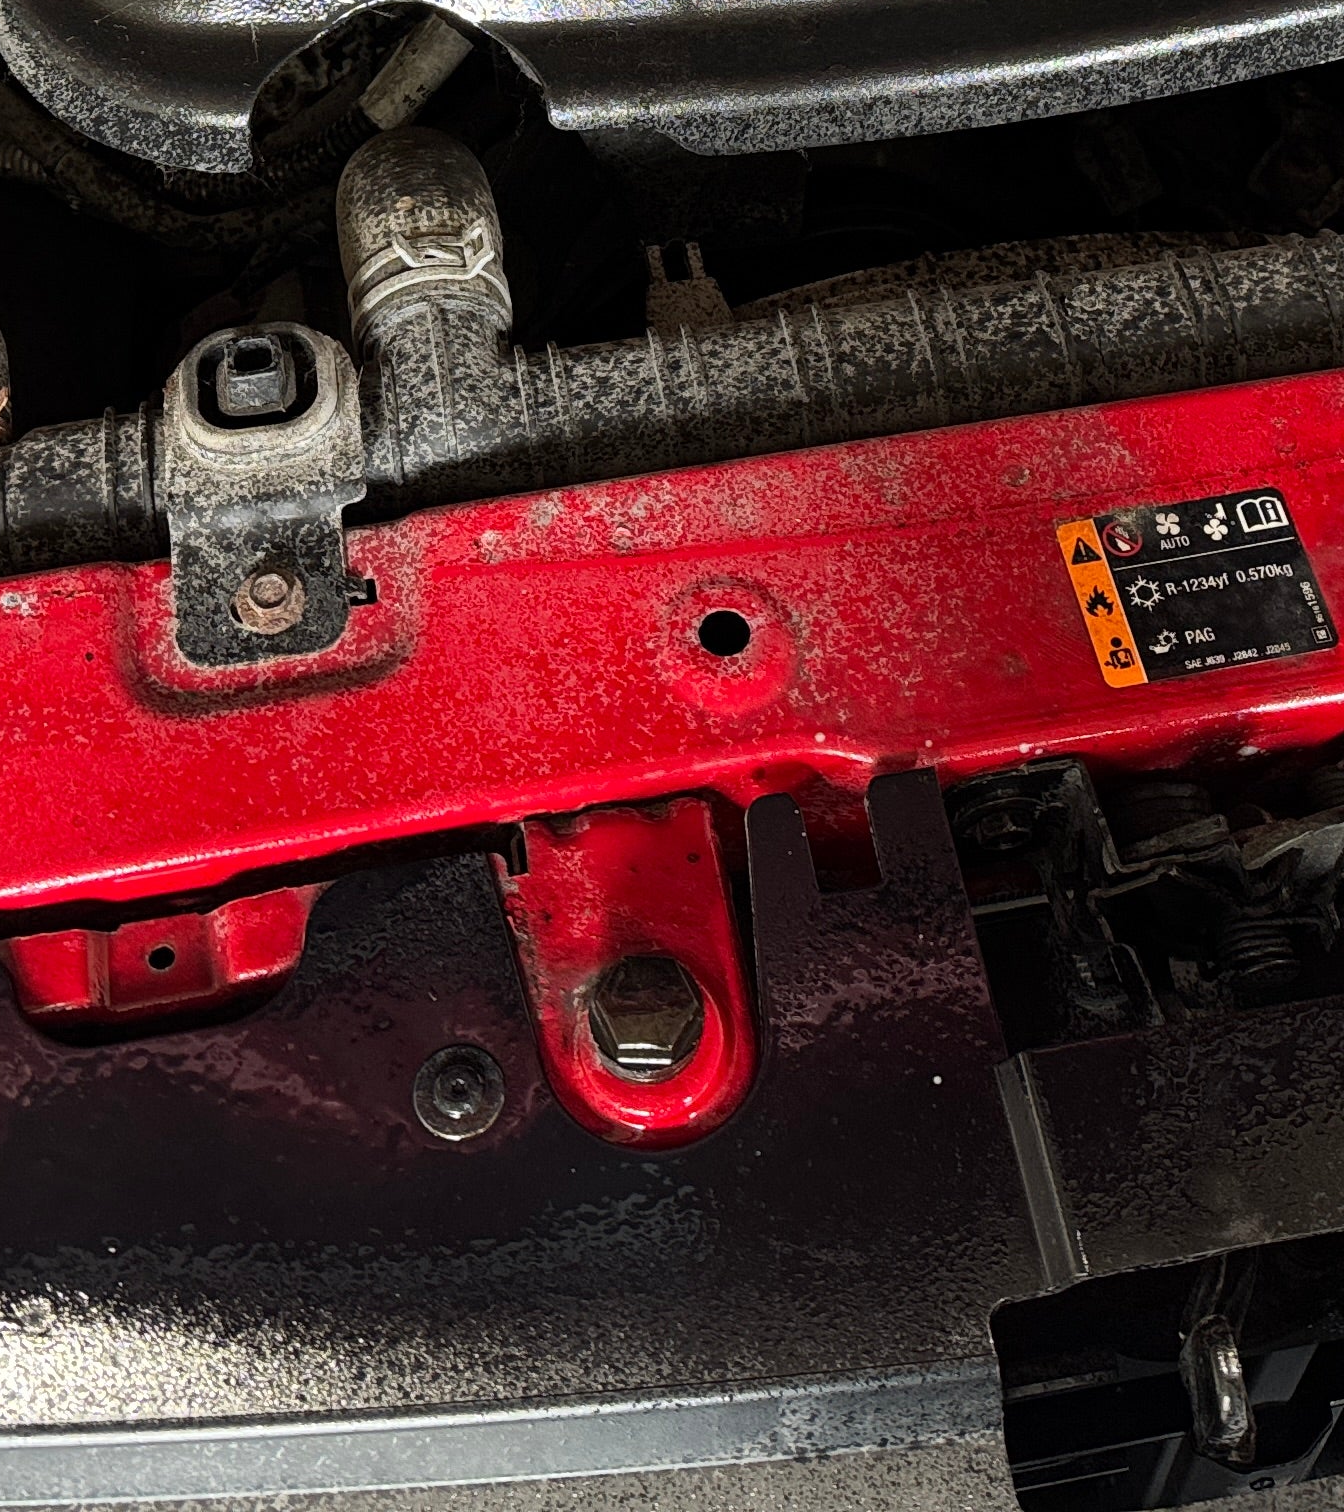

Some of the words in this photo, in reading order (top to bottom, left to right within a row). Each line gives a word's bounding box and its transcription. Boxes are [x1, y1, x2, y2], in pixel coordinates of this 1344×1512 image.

[1160, 535, 1191, 551] AUTO
[1165, 572, 1230, 596] R-1234yf
[1235, 563, 1294, 584] 0.570kg
[1184, 627, 1216, 645] PAG
[1184, 657, 1204, 670] SAE
